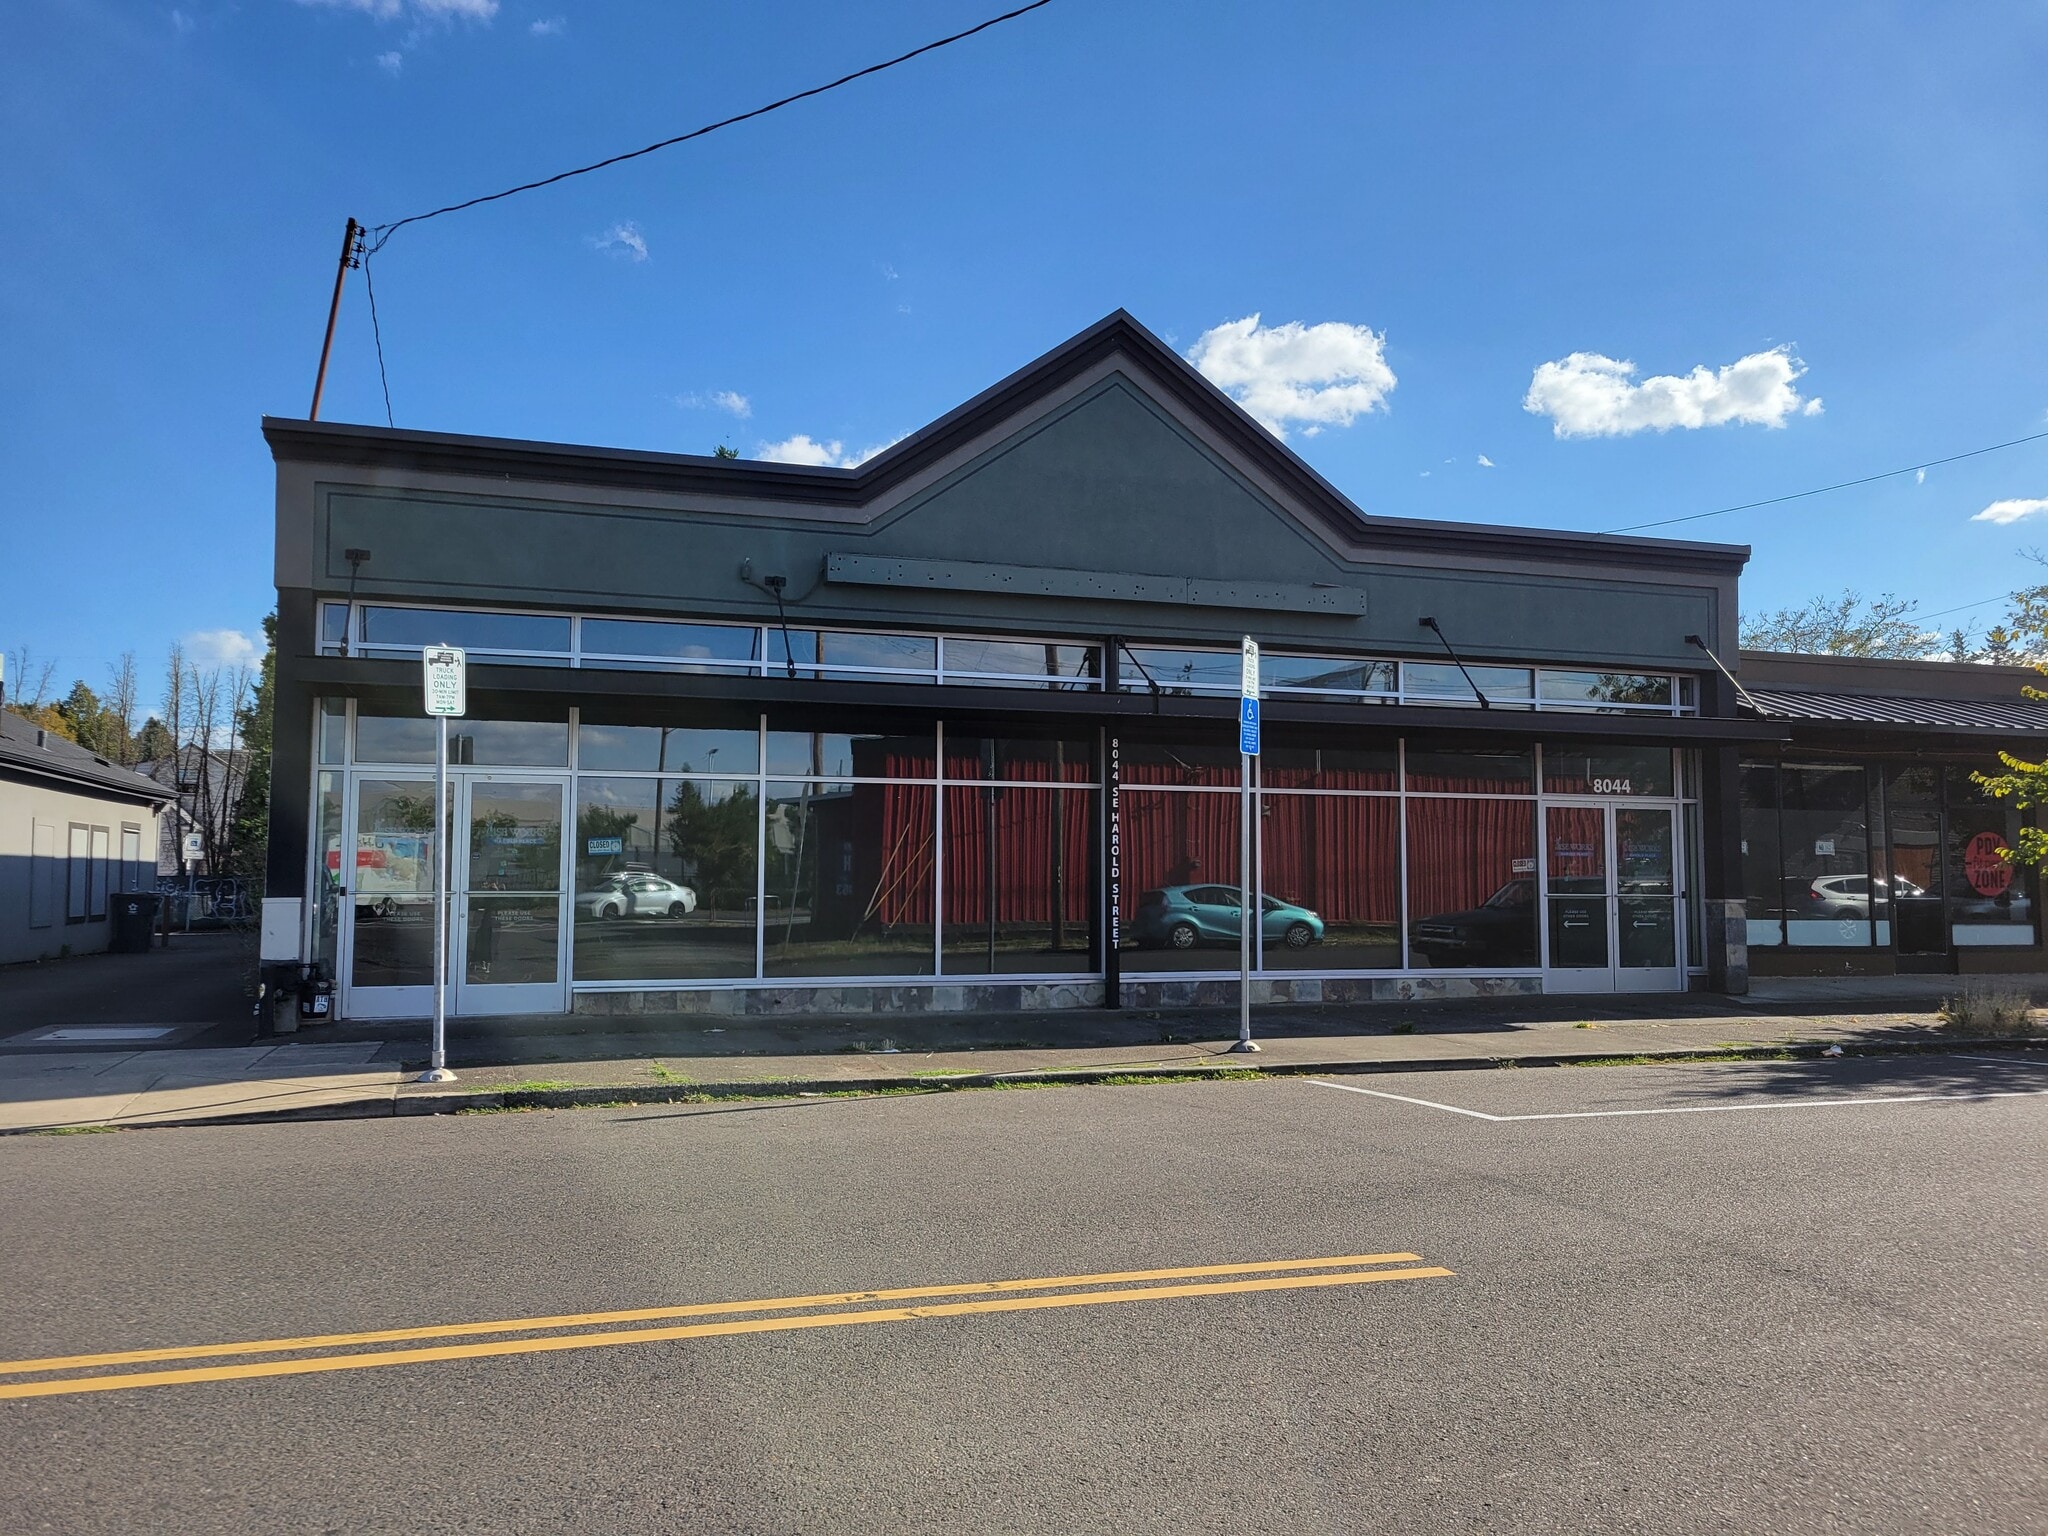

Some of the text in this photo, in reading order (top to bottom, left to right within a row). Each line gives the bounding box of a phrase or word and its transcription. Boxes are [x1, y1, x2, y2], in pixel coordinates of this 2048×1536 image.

[434, 680, 456, 688] ONLY
[1593, 778, 1631, 793] 8044
[1112, 787, 1119, 808] SE
[590, 840, 610, 849] CLOSED
[1111, 812, 1120, 878] HAROLD
[1974, 870, 2005, 888] ZONE
